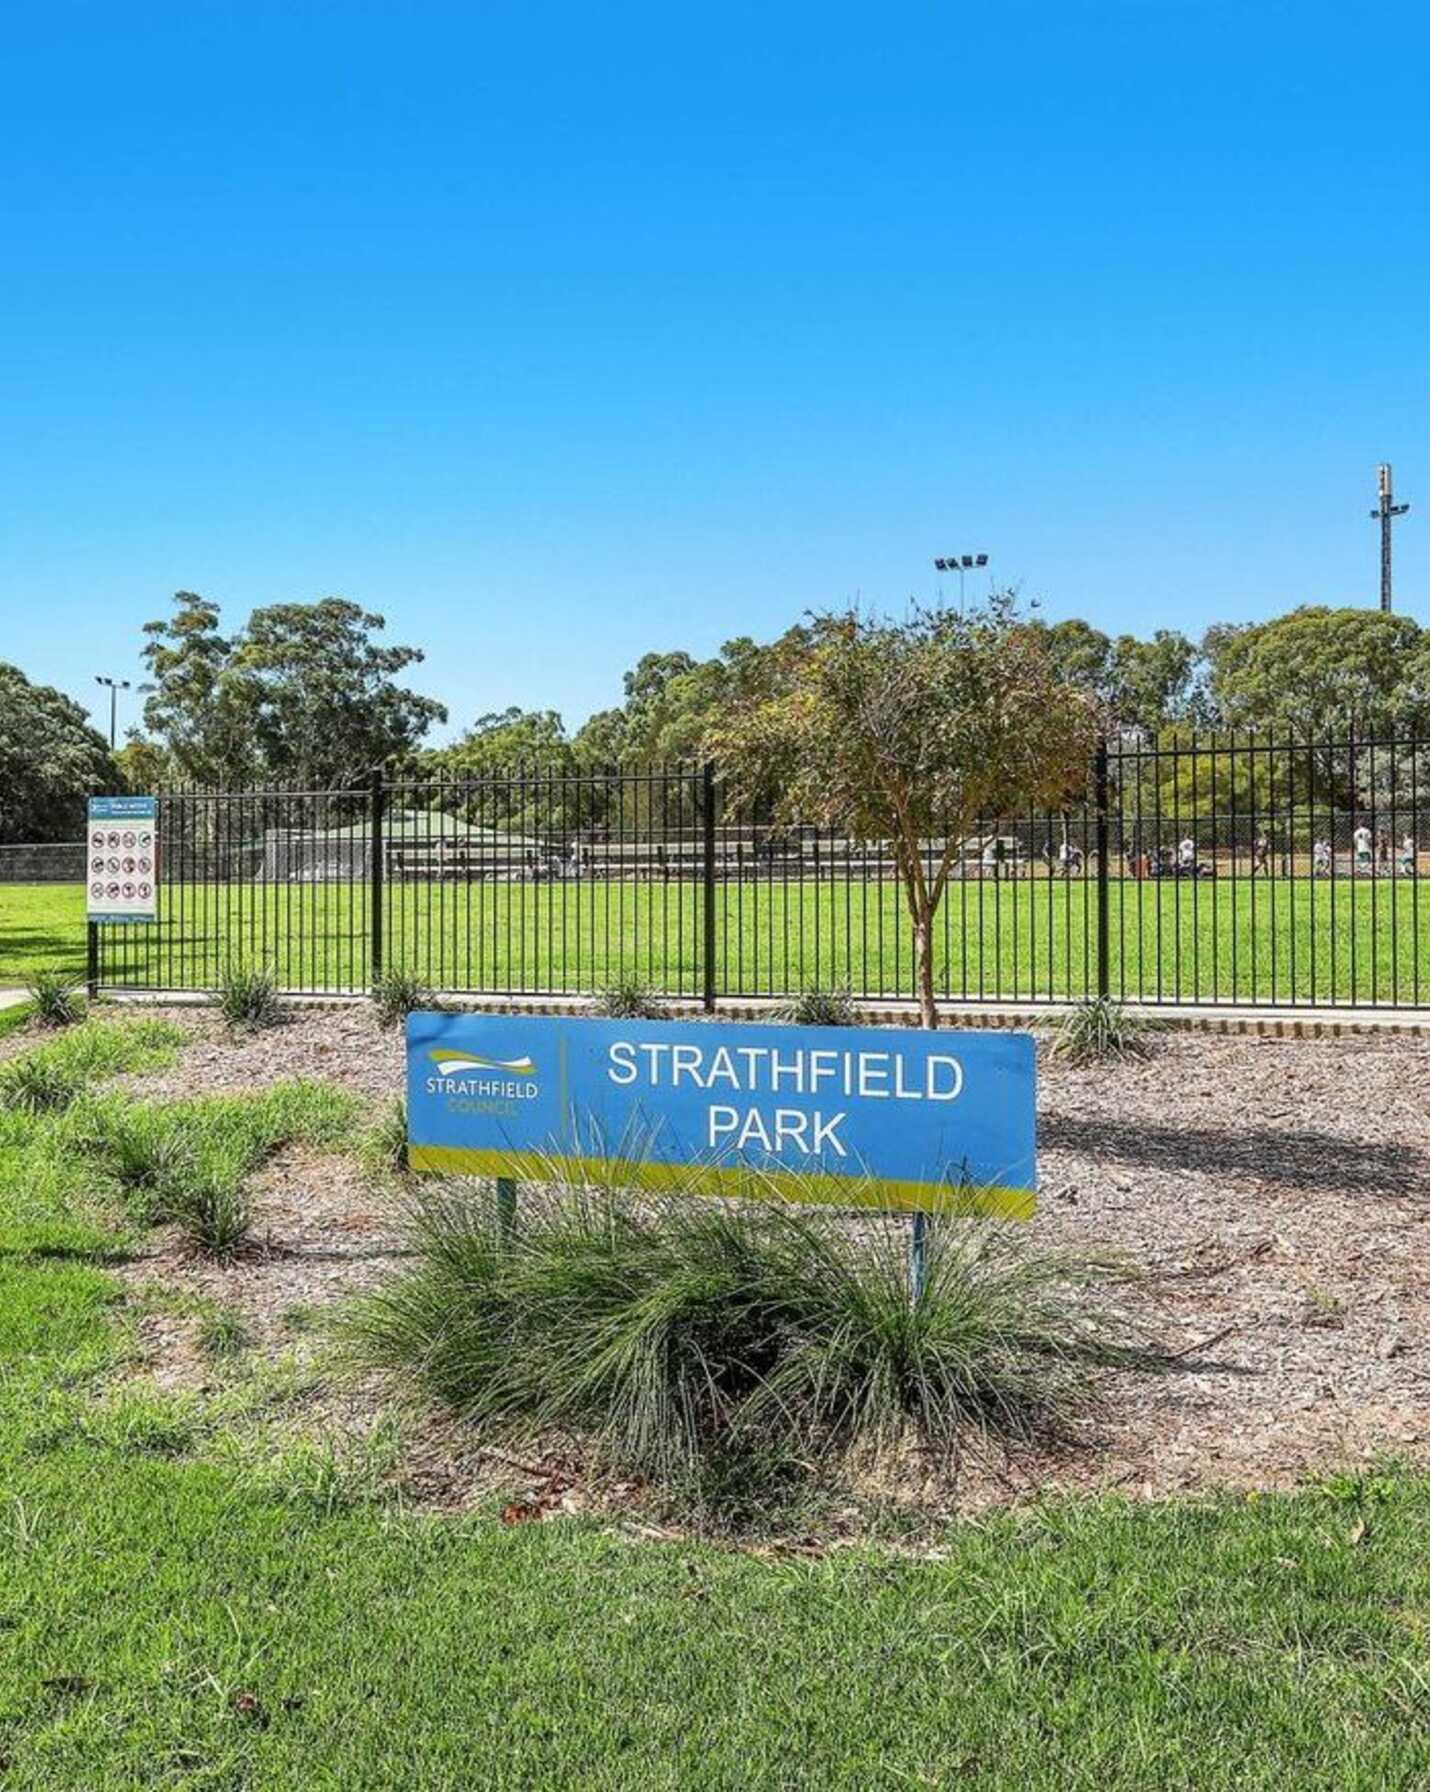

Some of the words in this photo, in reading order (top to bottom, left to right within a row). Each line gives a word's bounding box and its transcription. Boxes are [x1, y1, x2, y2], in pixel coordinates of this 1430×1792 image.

[426, 1077, 538, 1098] STRATHFIELD
[607, 1041, 964, 1101] STRATHFIELD
[708, 1105, 848, 1157] PARK
